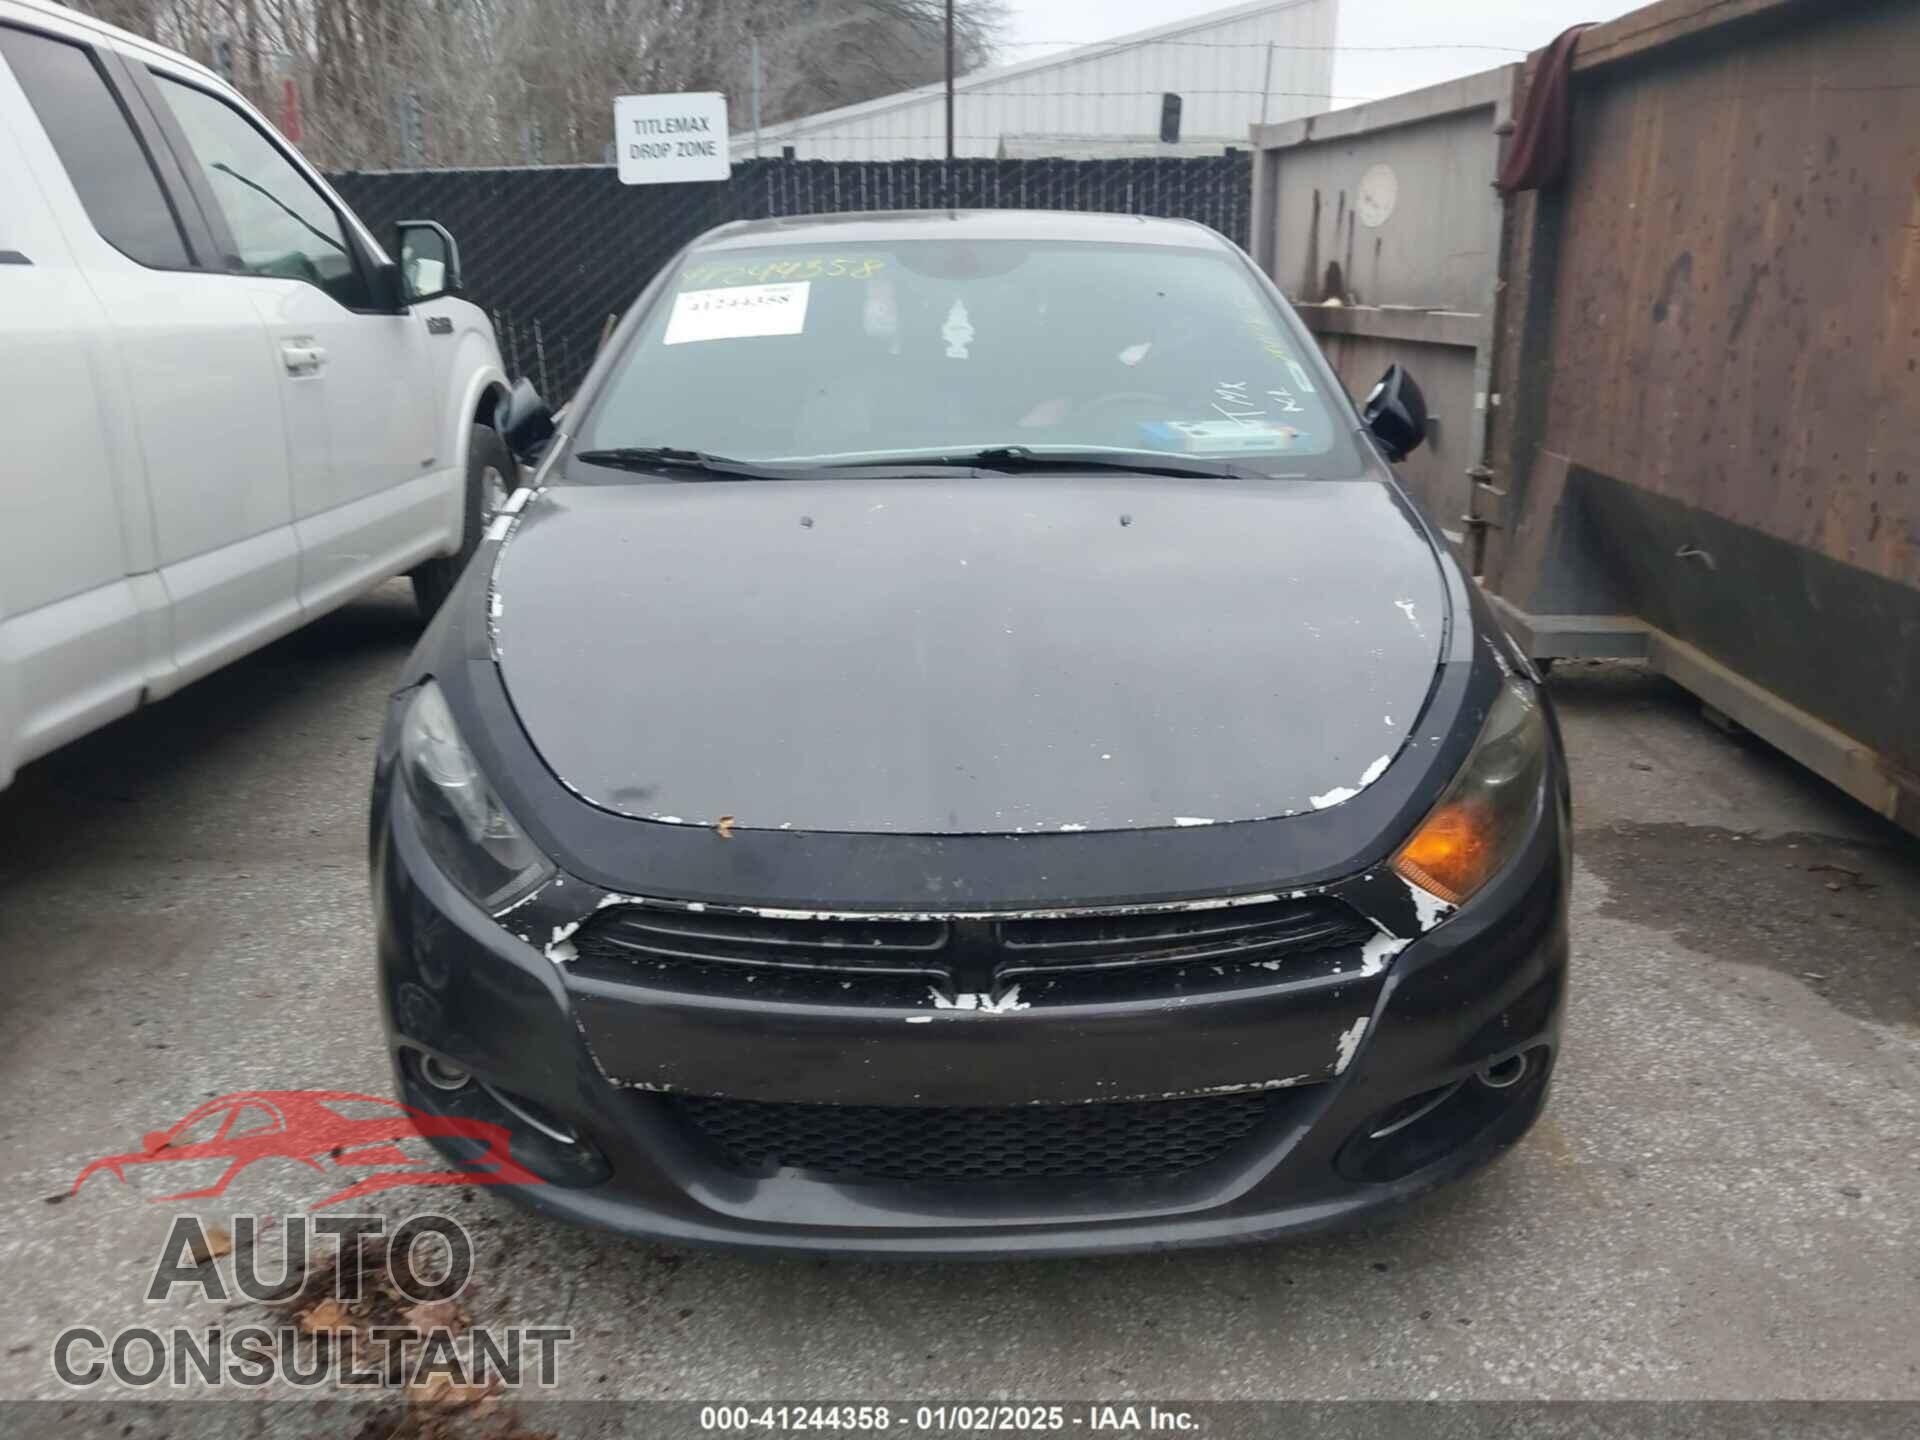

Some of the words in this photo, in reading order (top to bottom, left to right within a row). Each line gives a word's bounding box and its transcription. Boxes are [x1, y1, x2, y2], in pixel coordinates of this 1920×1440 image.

[632, 115, 712, 135] TITLEMAX
[629, 142, 672, 160] DROP
[676, 140, 718, 158] ZONE
